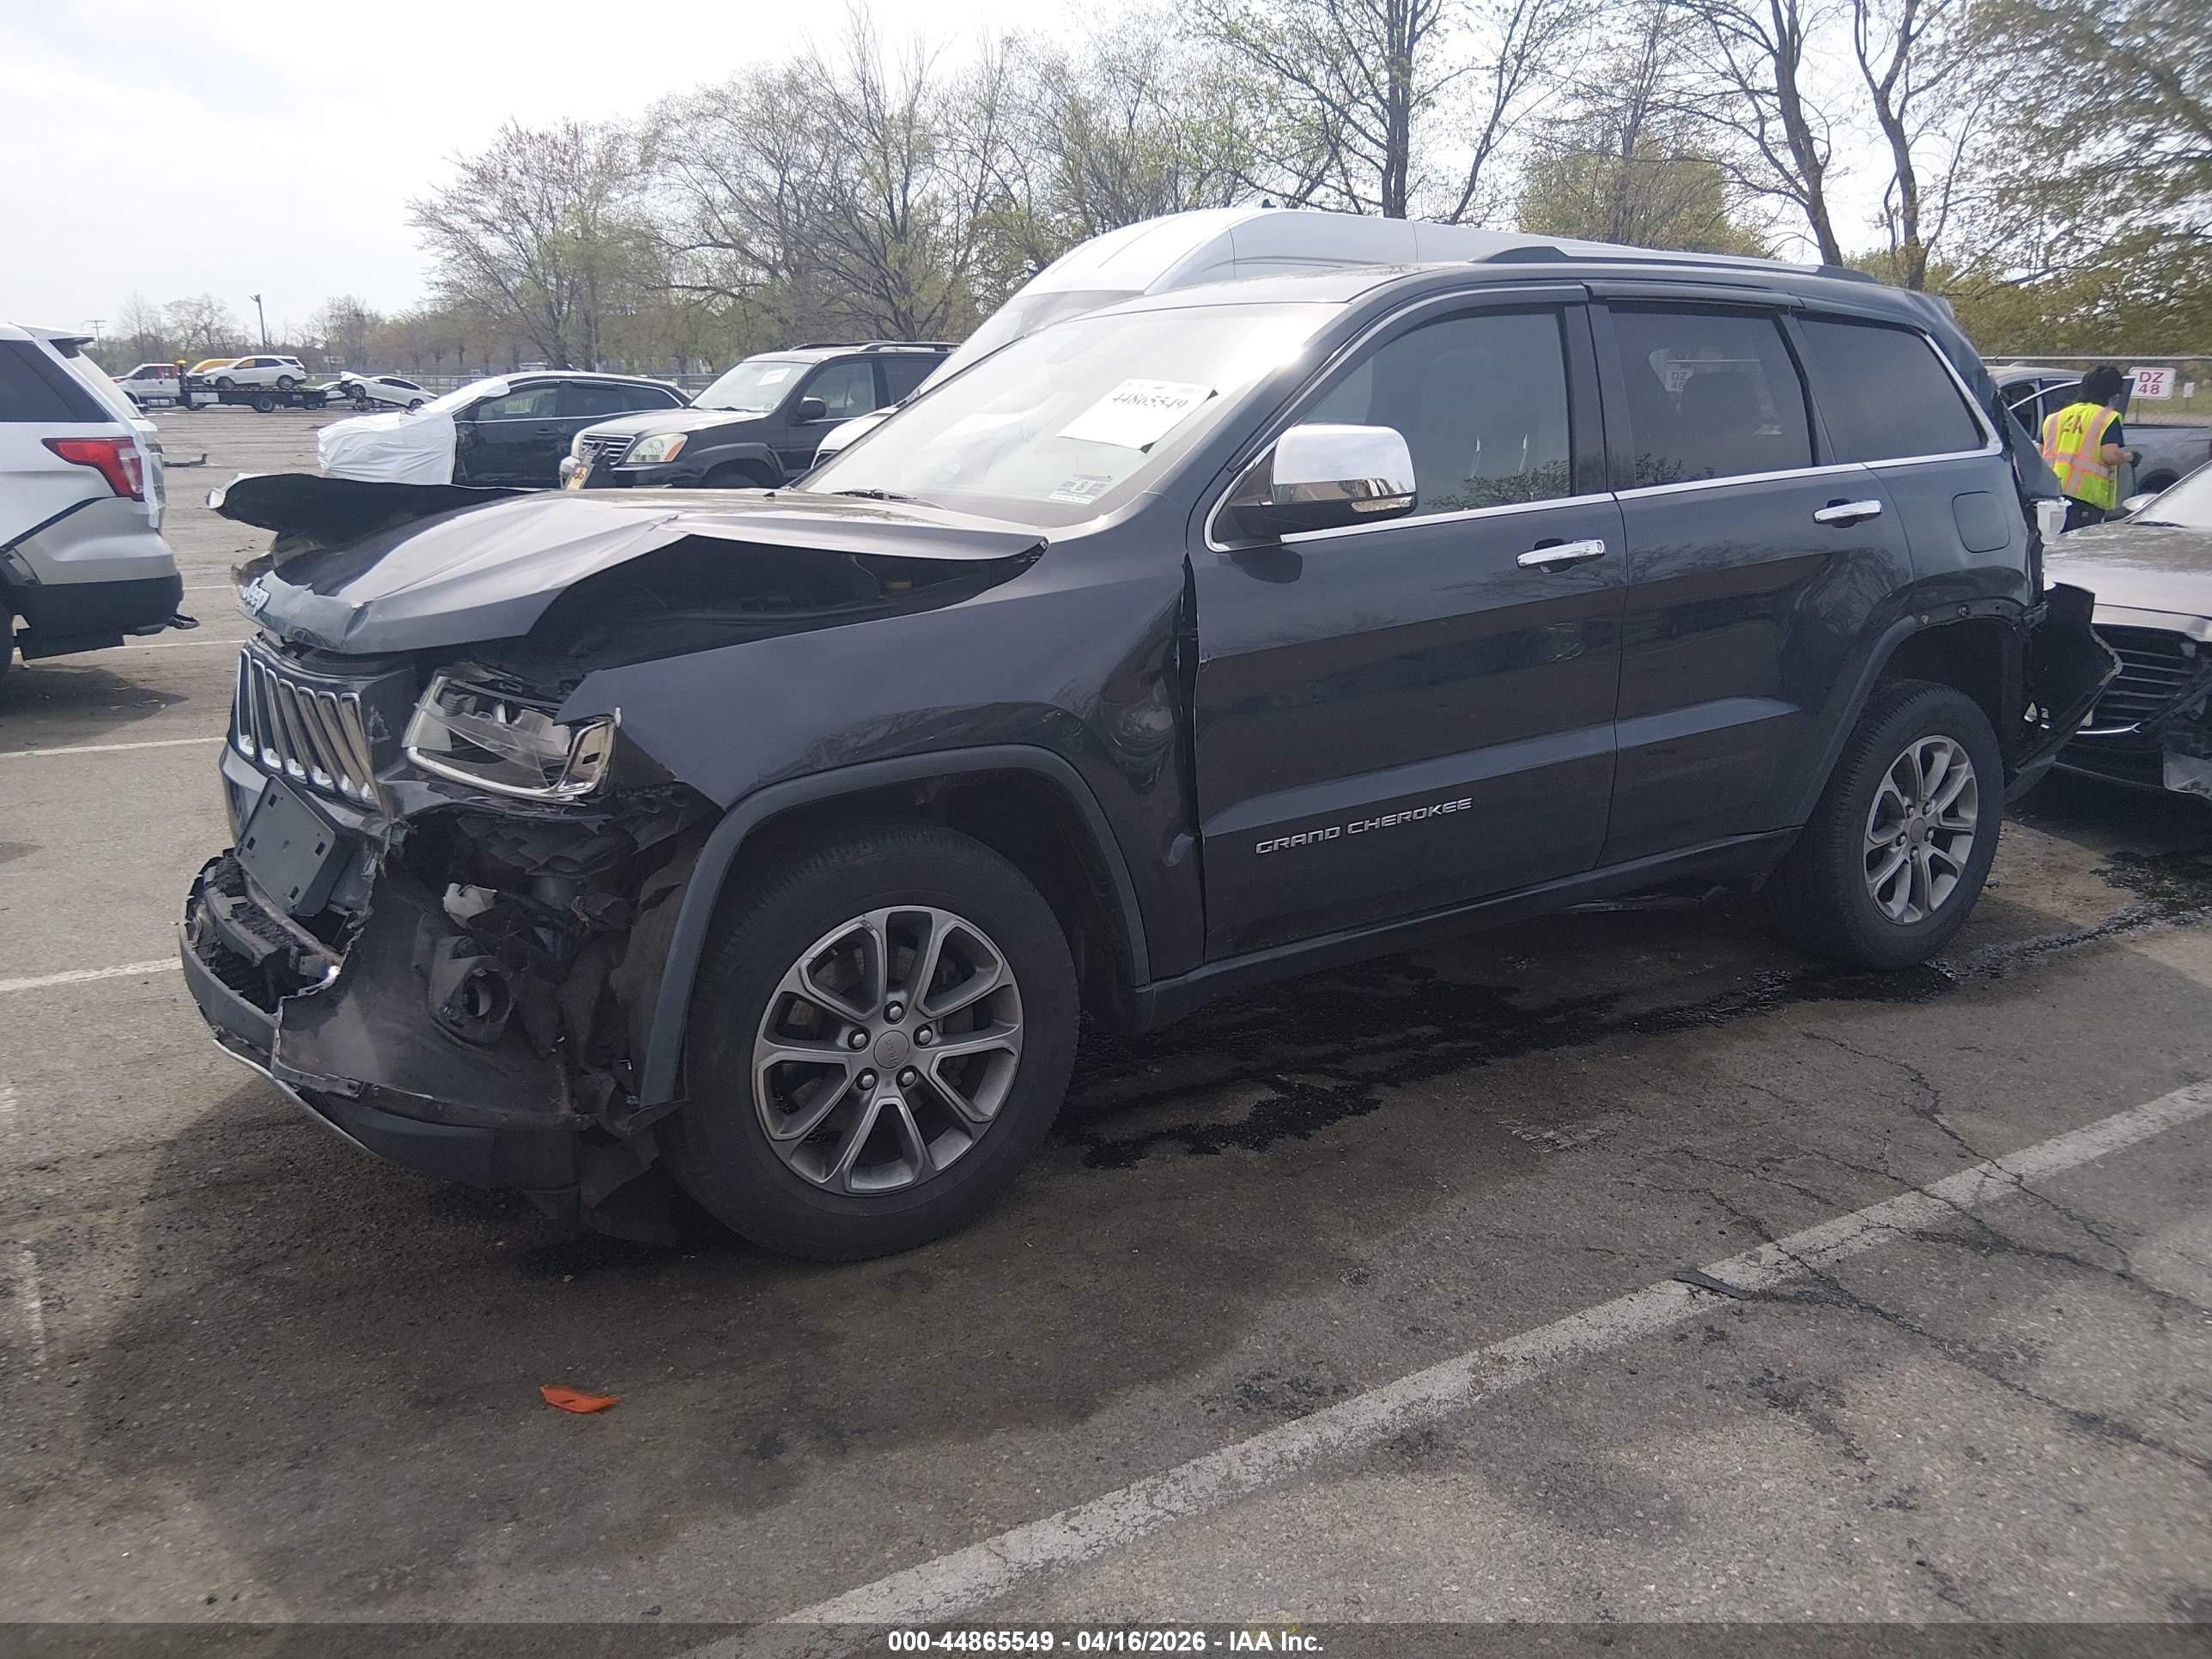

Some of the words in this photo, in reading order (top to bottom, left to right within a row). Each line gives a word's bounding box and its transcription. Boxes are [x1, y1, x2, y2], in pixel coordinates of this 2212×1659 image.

[1670, 371, 1687, 381] DZ
[2138, 371, 2165, 383] DZ
[2137, 384, 2160, 395] 48
[1255, 826, 1341, 855] GRAND
[1347, 797, 1474, 836] CHEROKEE
